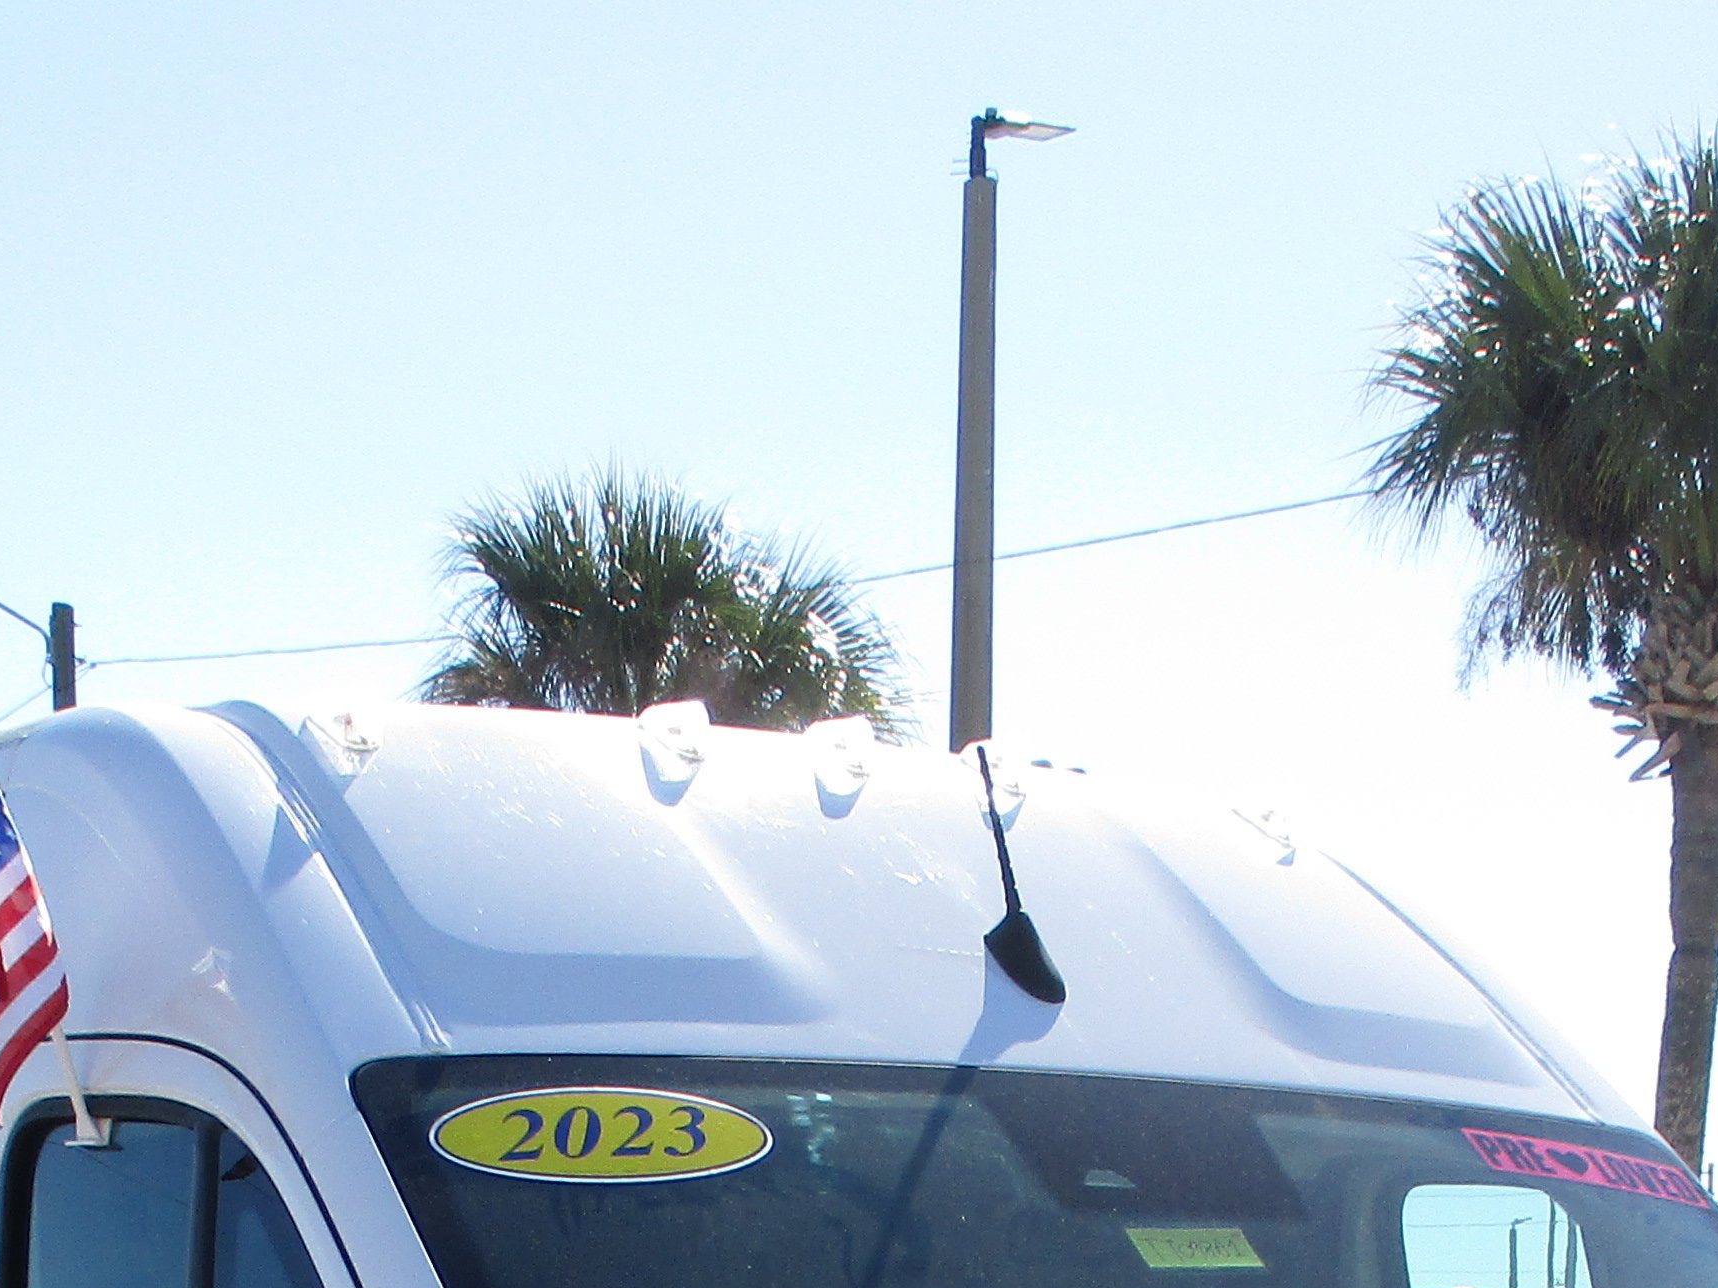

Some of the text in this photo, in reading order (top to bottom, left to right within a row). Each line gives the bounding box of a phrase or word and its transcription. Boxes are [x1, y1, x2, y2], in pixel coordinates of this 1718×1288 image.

[499, 1106, 707, 1161] 2023
[1474, 1132, 1702, 1203] PRE LOVED
